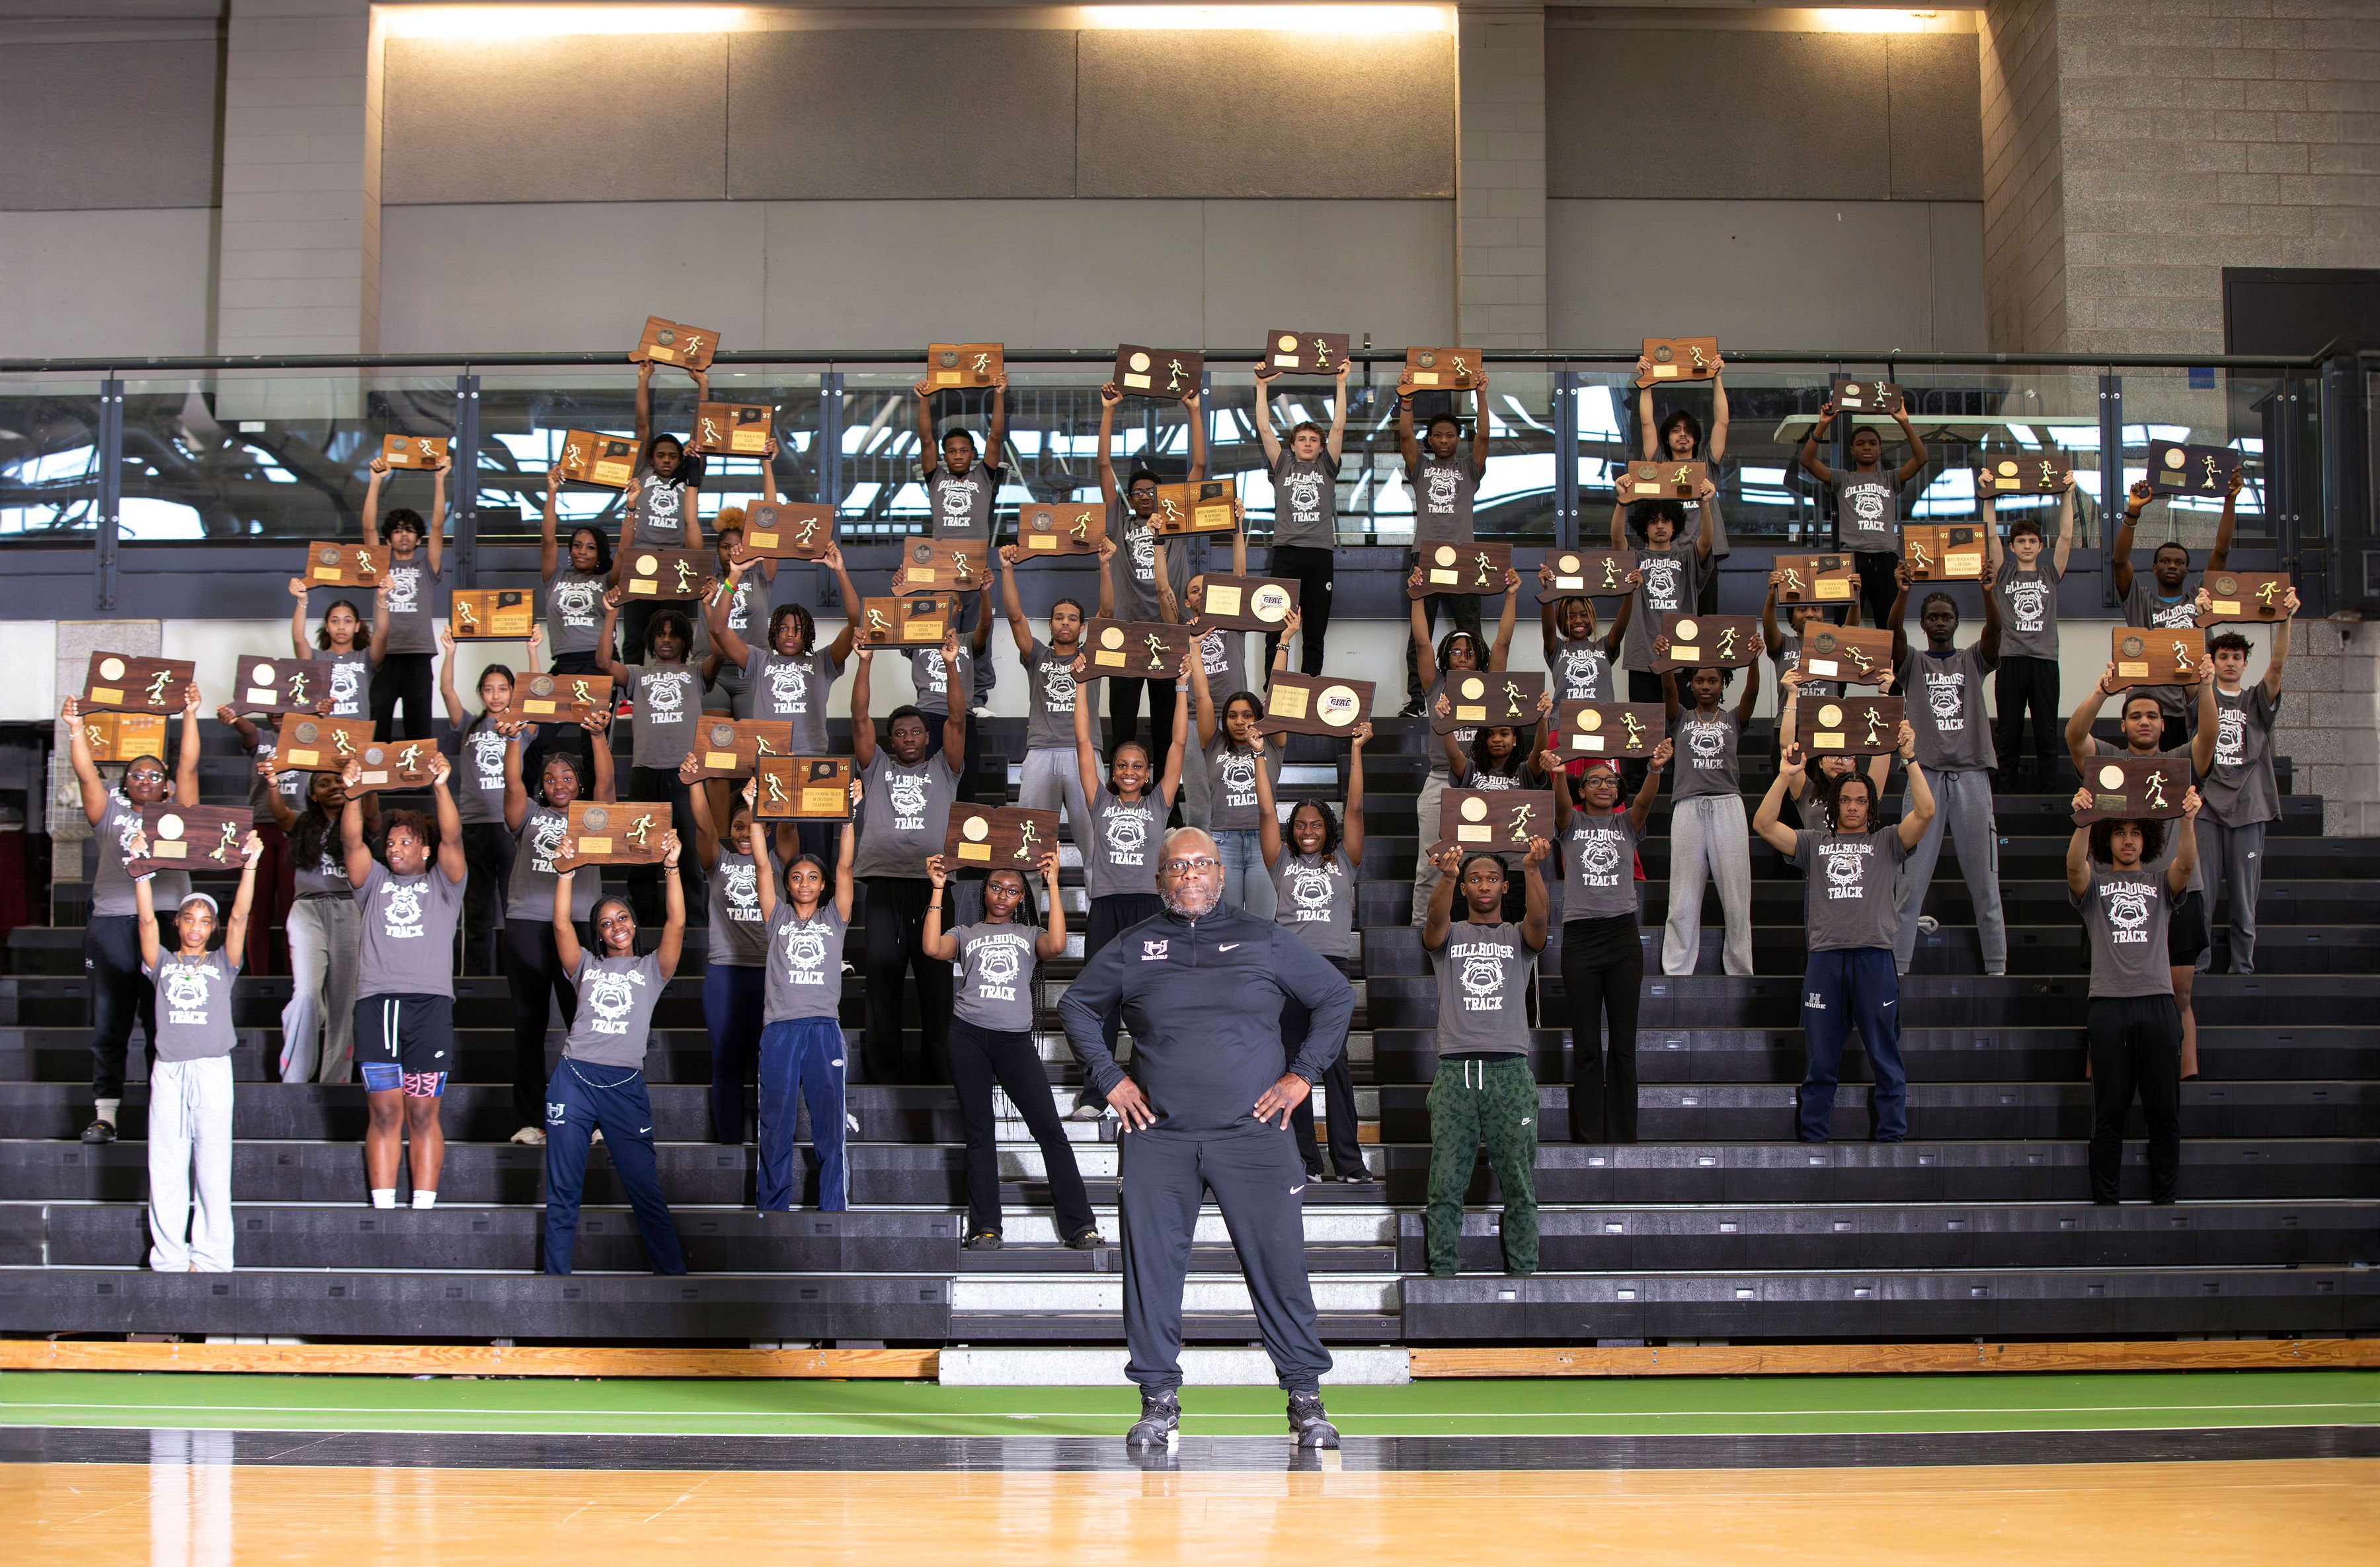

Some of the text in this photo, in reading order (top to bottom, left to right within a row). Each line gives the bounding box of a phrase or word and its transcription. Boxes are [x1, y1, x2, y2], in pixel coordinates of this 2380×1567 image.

[1844, 483, 1890, 498] HILLHOUSE
[1427, 504, 1454, 514] TRACK
[648, 515, 678, 528] TRACK
[943, 516, 971, 527] TRACK
[1292, 512, 1320, 522] TRACK
[1858, 520, 1884, 531] TRACK
[1640, 558, 1681, 572] HILLHOUSE
[1136, 569, 1155, 580] TRA
[388, 602, 418, 612] TRACK
[1649, 600, 1677, 610] TRACK
[2152, 604, 2198, 624] HILLHOUSE
[563, 616, 594, 627] TRACK
[728, 618, 748, 629] ACK
[2015, 621, 2043, 631] TRACK
[1204, 661, 1229, 674] RACK
[641, 672, 692, 686] HILLHOUSE
[930, 682, 947, 693] TRA
[1566, 688, 1596, 700] TRACK
[331, 702, 359, 715] RACK
[774, 703, 806, 713] TRACK
[651, 712, 684, 724] TRACK
[1454, 729, 1478, 742] RACK
[1692, 758, 1724, 770] TRACK
[479, 777, 505, 789] TRAC
[1102, 806, 1154, 822] HILLHOUSE
[894, 817, 925, 830] TRACK
[1573, 828, 1626, 842] HILLHOUSE
[1819, 843, 1874, 857] HILLHOUSE
[1109, 851, 1144, 865] TRACK
[532, 859, 557, 873] TRA
[1583, 874, 1619, 887] TRACK
[1828, 887, 1863, 899] TRACK
[2100, 881, 2158, 899] HILLHOUSE
[1296, 909, 1331, 922] TRACK
[385, 924, 424, 938] TRACK
[2112, 930, 2148, 944] TRACK
[965, 933, 1031, 958] HILLHOUSE
[1450, 942, 1514, 960] HILLHOUSE
[788, 970, 824, 984] TRACK
[978, 984, 1016, 1001] TRACK
[1462, 996, 1503, 1011] TRACK
[1805, 1001, 1826, 1010] HOUSE
[168, 1010, 208, 1025] TRACK
[590, 1019, 629, 1035] TRACK
